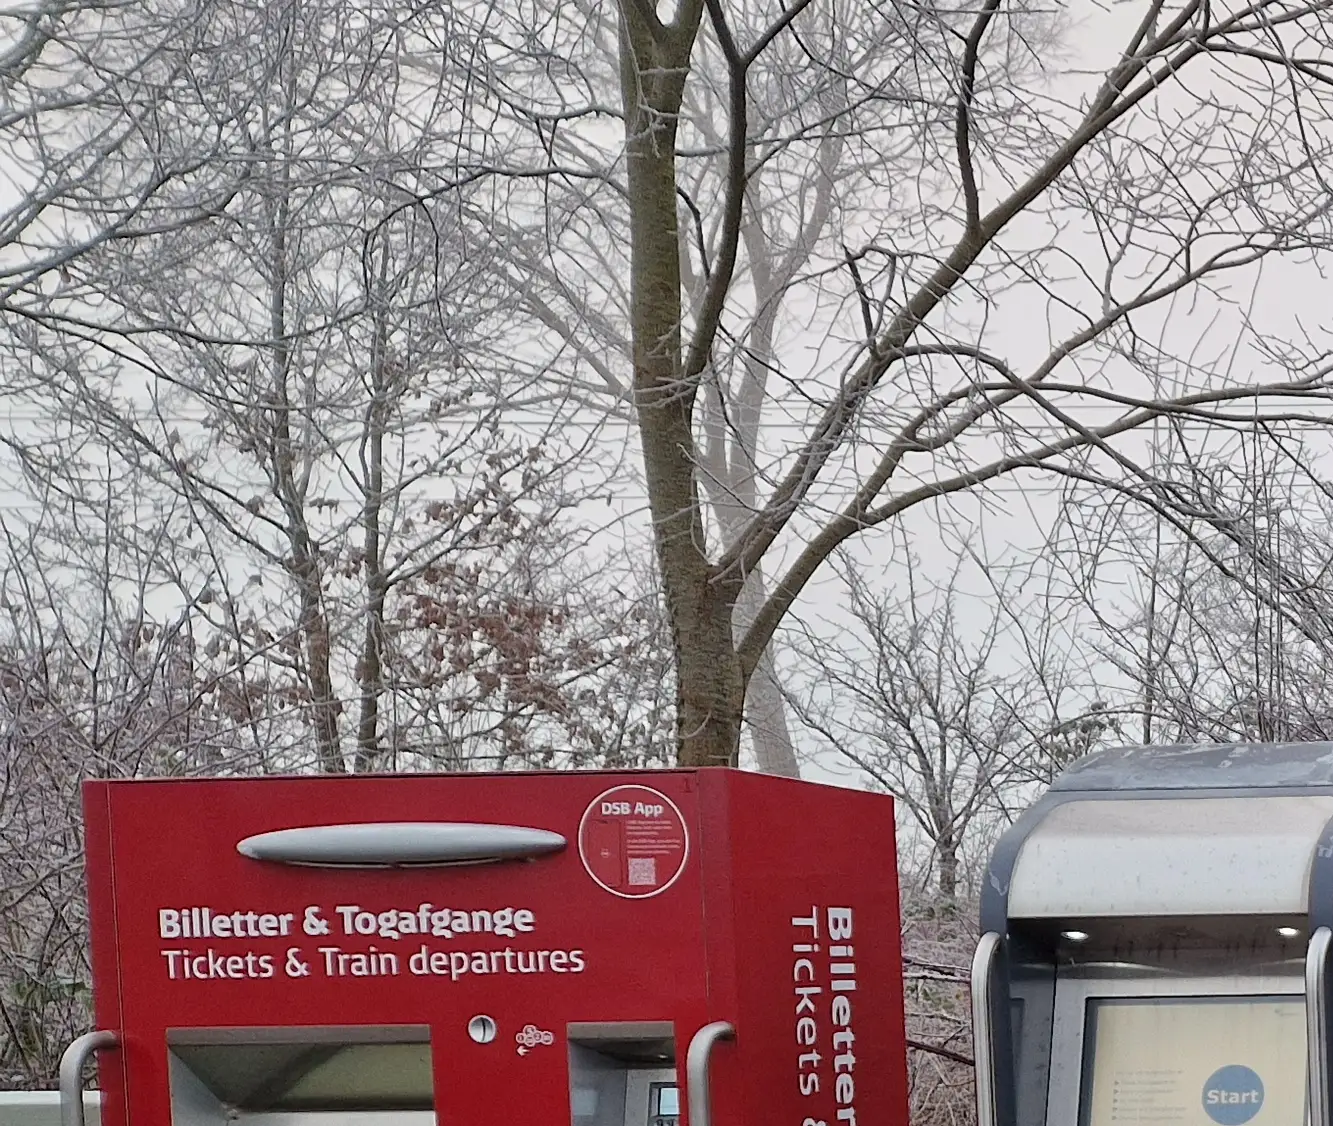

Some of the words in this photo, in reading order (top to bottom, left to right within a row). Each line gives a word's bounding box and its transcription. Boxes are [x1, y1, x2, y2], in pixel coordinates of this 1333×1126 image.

[601, 802, 631, 815] DSB
[634, 802, 664, 817] App
[159, 908, 294, 939] Billetter
[303, 907, 329, 936] &
[336, 904, 535, 940] Togafgange
[161, 948, 274, 980] Tickets
[285, 947, 309, 977] &
[319, 945, 398, 977] Train
[409, 944, 585, 981] departures
[790, 905, 822, 1095] Tickets
[1206, 1089, 1259, 1104] Start
